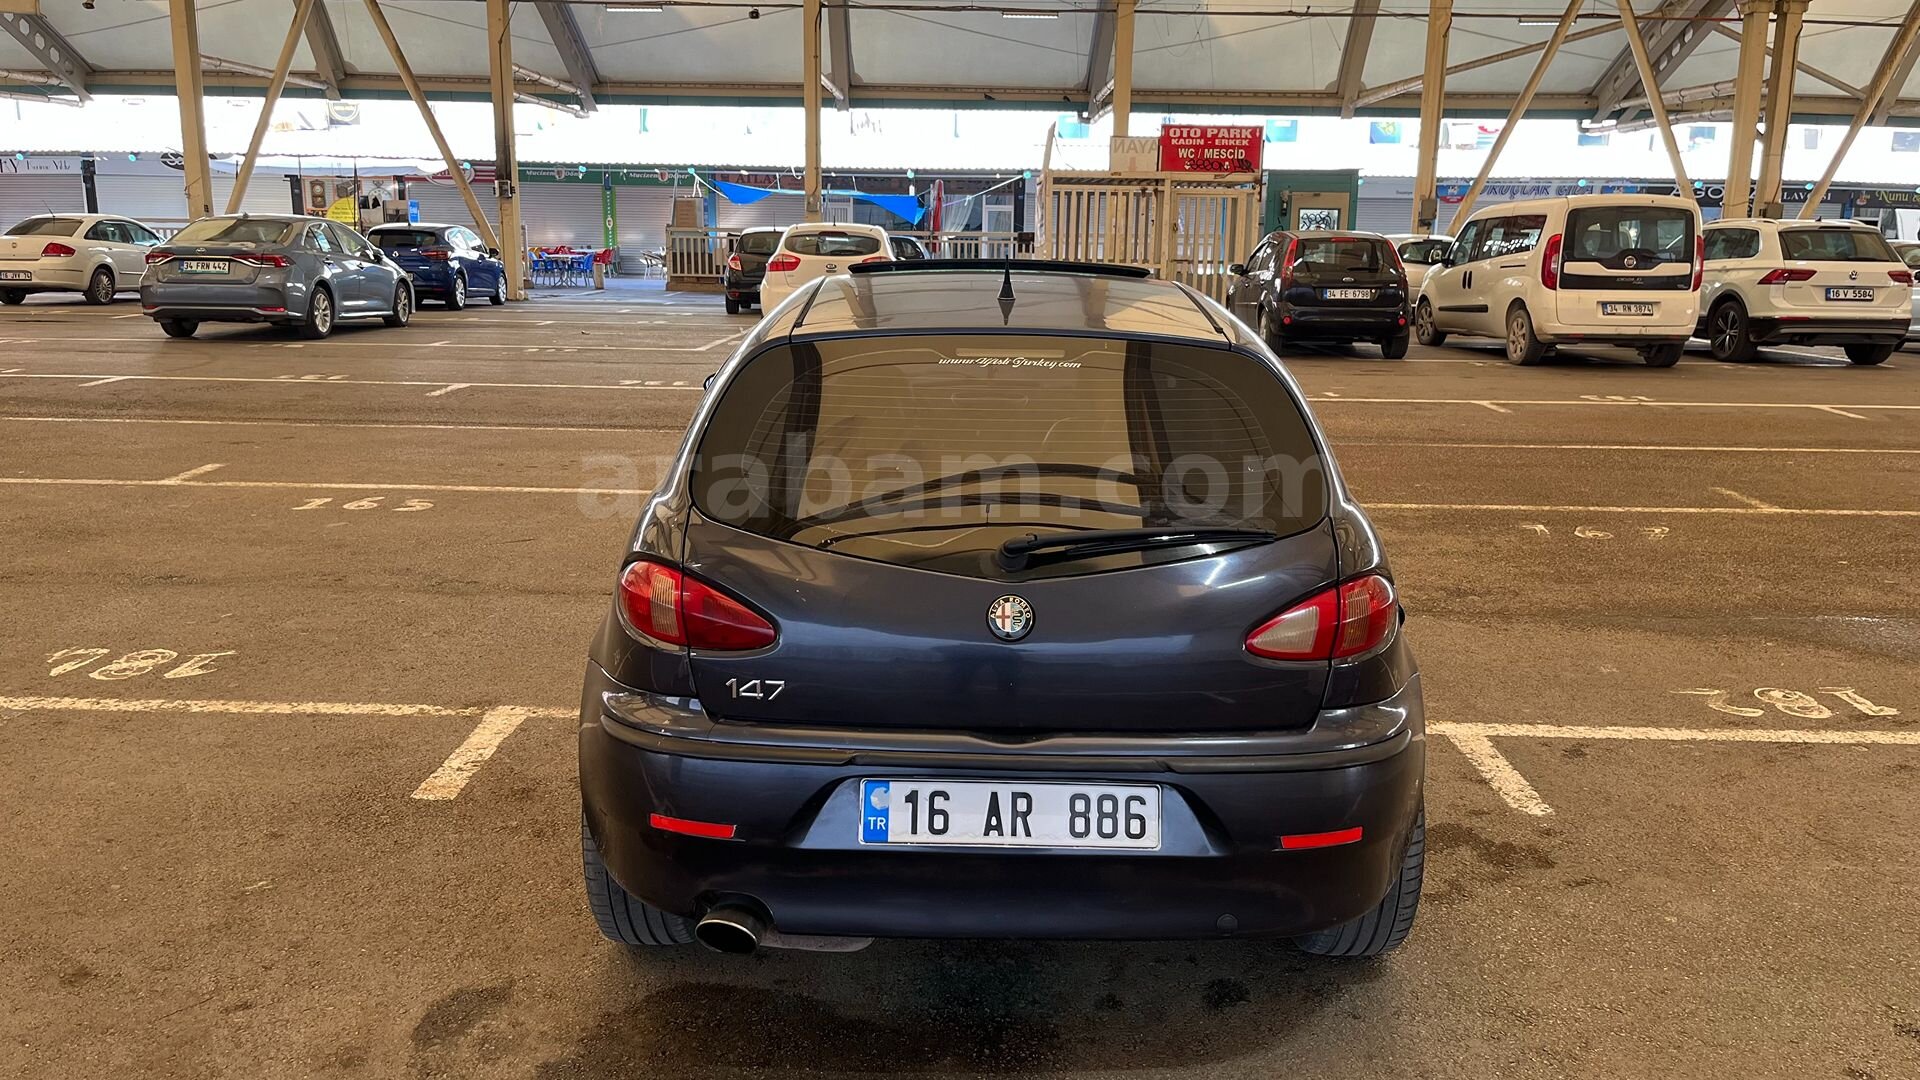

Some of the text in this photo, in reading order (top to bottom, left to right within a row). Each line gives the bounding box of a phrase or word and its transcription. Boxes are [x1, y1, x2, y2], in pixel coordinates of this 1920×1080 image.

[1169, 127, 1252, 139] OTO PARK
[1171, 138, 1204, 146] KADIN
[1215, 138, 1249, 146] ERKEK
[1178, 148, 1195, 159] WC
[1204, 146, 1245, 160] MESCİD
[183, 262, 193, 270] 34
[213, 262, 227, 271] 442
[1328, 289, 1370, 298] 34 FE 6798
[1609, 304, 1617, 312] 34
[292, 497, 434, 512] 165
[726, 678, 785, 700] 147
[868, 789, 1147, 839] TR 16 AR 886
